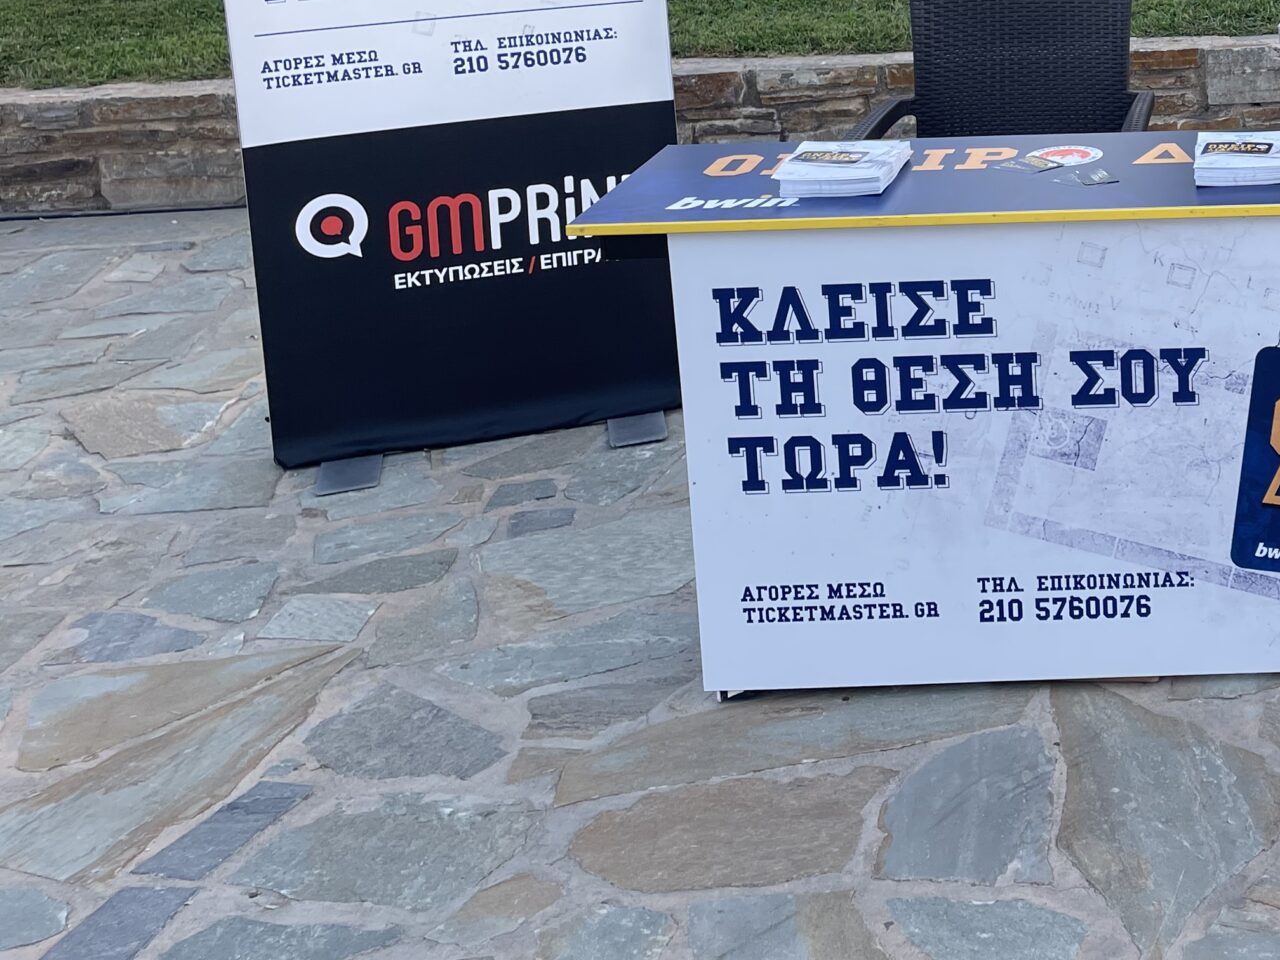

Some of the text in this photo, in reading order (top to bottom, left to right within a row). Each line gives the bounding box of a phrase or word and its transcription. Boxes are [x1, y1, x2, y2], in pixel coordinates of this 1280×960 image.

[497, 27, 618, 50] ΕΠΙΚΟΙΝΩΝΙΑΣ:
[260, 49, 379, 75] ΑΓΟΡΕΣ ΜΕΣΩ
[453, 46, 588, 76] 210 5760076
[664, 193, 798, 210] bwin
[394, 257, 524, 290] ΕΚΤΥΠΩΣΕΙΣ
[711, 278, 997, 347] ΚΛΕΙΣΕ
[720, 347, 1210, 419] ΤΗ ΘΕΣΗ ΣΟΥ
[727, 430, 951, 495] ΤΩΡΑ!
[740, 581, 886, 603] ΑΓΟΡΕΣ ΜΕΣΩ
[1036, 571, 1195, 592] ΕΠΙΚΟΙΝΩΝΙΑΣ:
[978, 595, 1152, 623] 210 5760076
